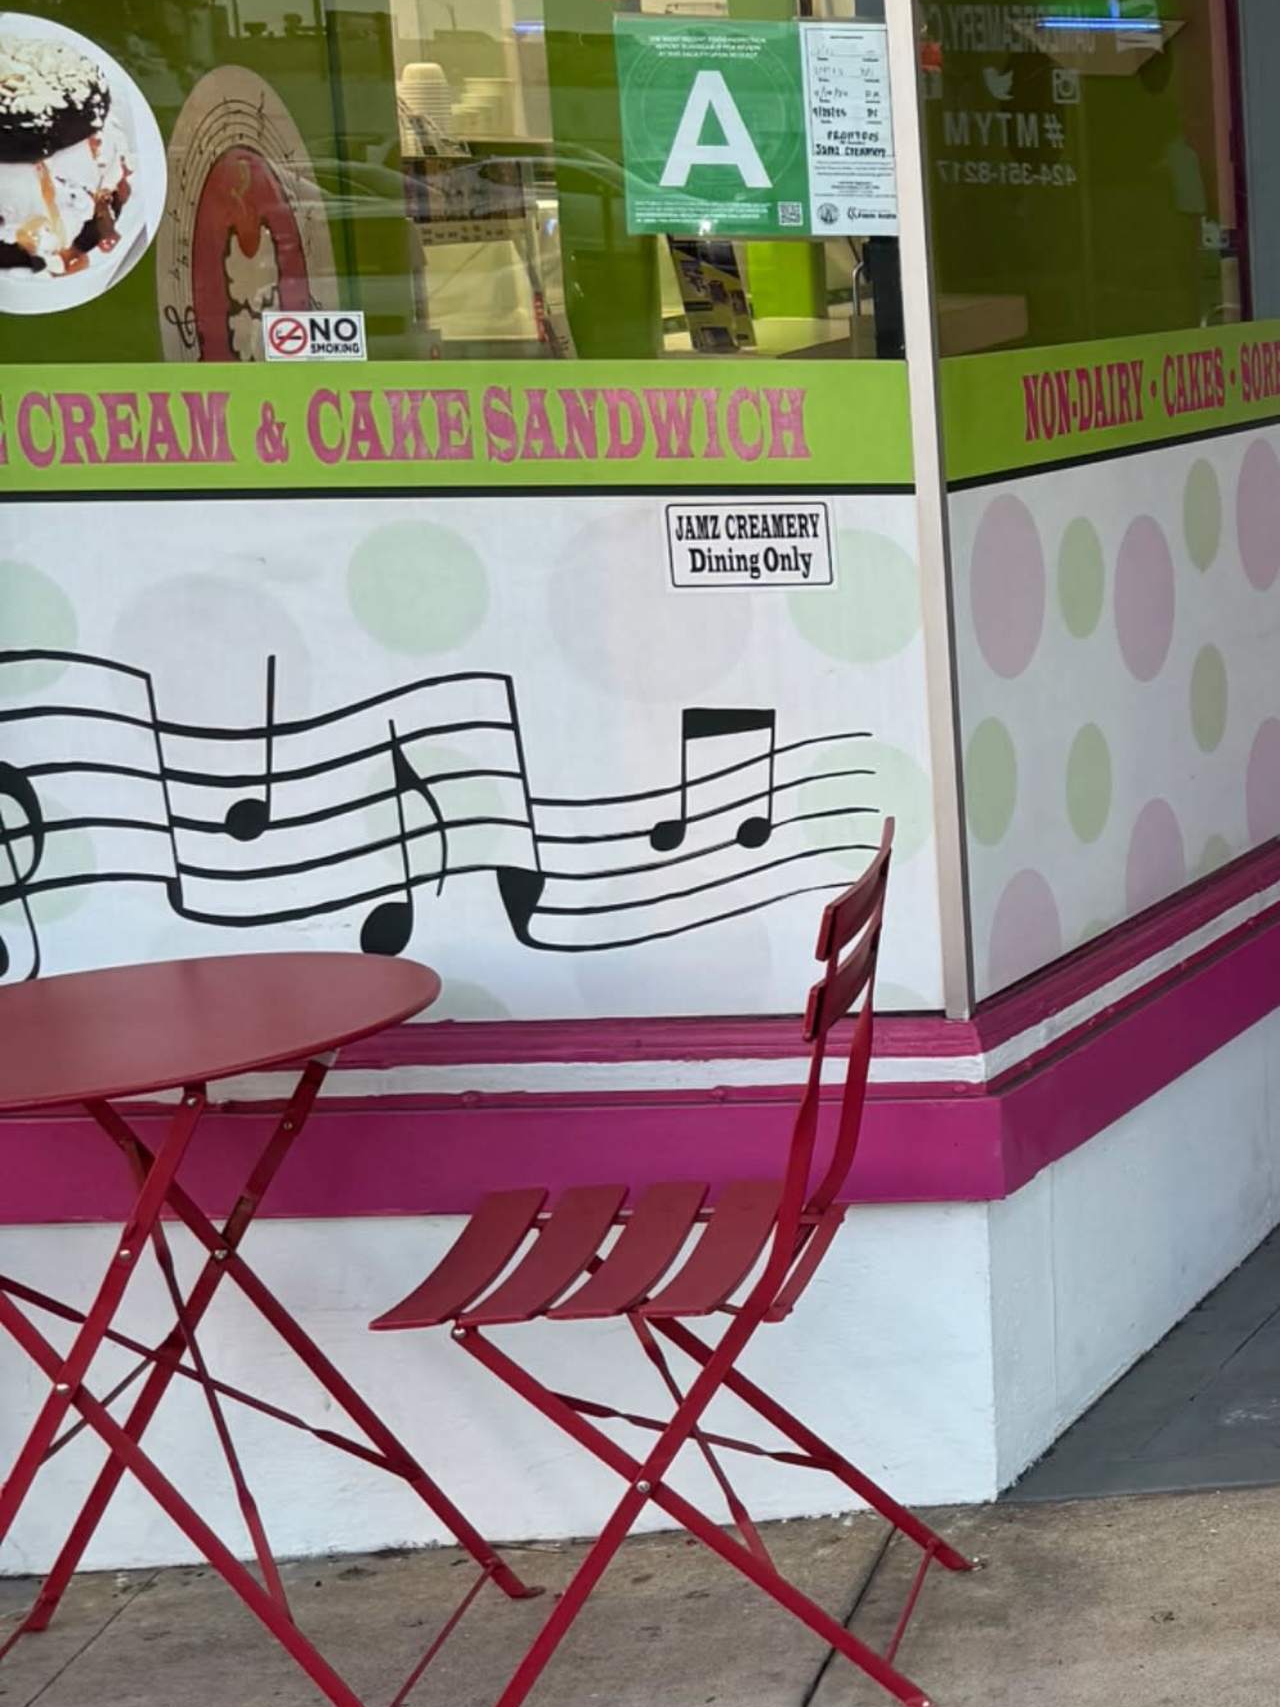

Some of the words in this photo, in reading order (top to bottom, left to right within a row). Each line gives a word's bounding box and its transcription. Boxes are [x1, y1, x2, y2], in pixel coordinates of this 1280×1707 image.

[659, 70, 772, 189] A
[309, 317, 358, 342] NO
[310, 343, 360, 354] SMOKING
[1022, 359, 1144, 442] NON-DAIRY
[1162, 347, 1225, 417] CAKES
[14, 388, 236, 468] CREAM
[256, 400, 289, 465] &
[307, 388, 472, 466] CAKE
[486, 386, 812, 464] SANDWICH
[675, 515, 721, 542] JAMZ
[725, 513, 820, 540] CREAMERY
[688, 547, 761, 579] Dining
[763, 545, 812, 579] Only
